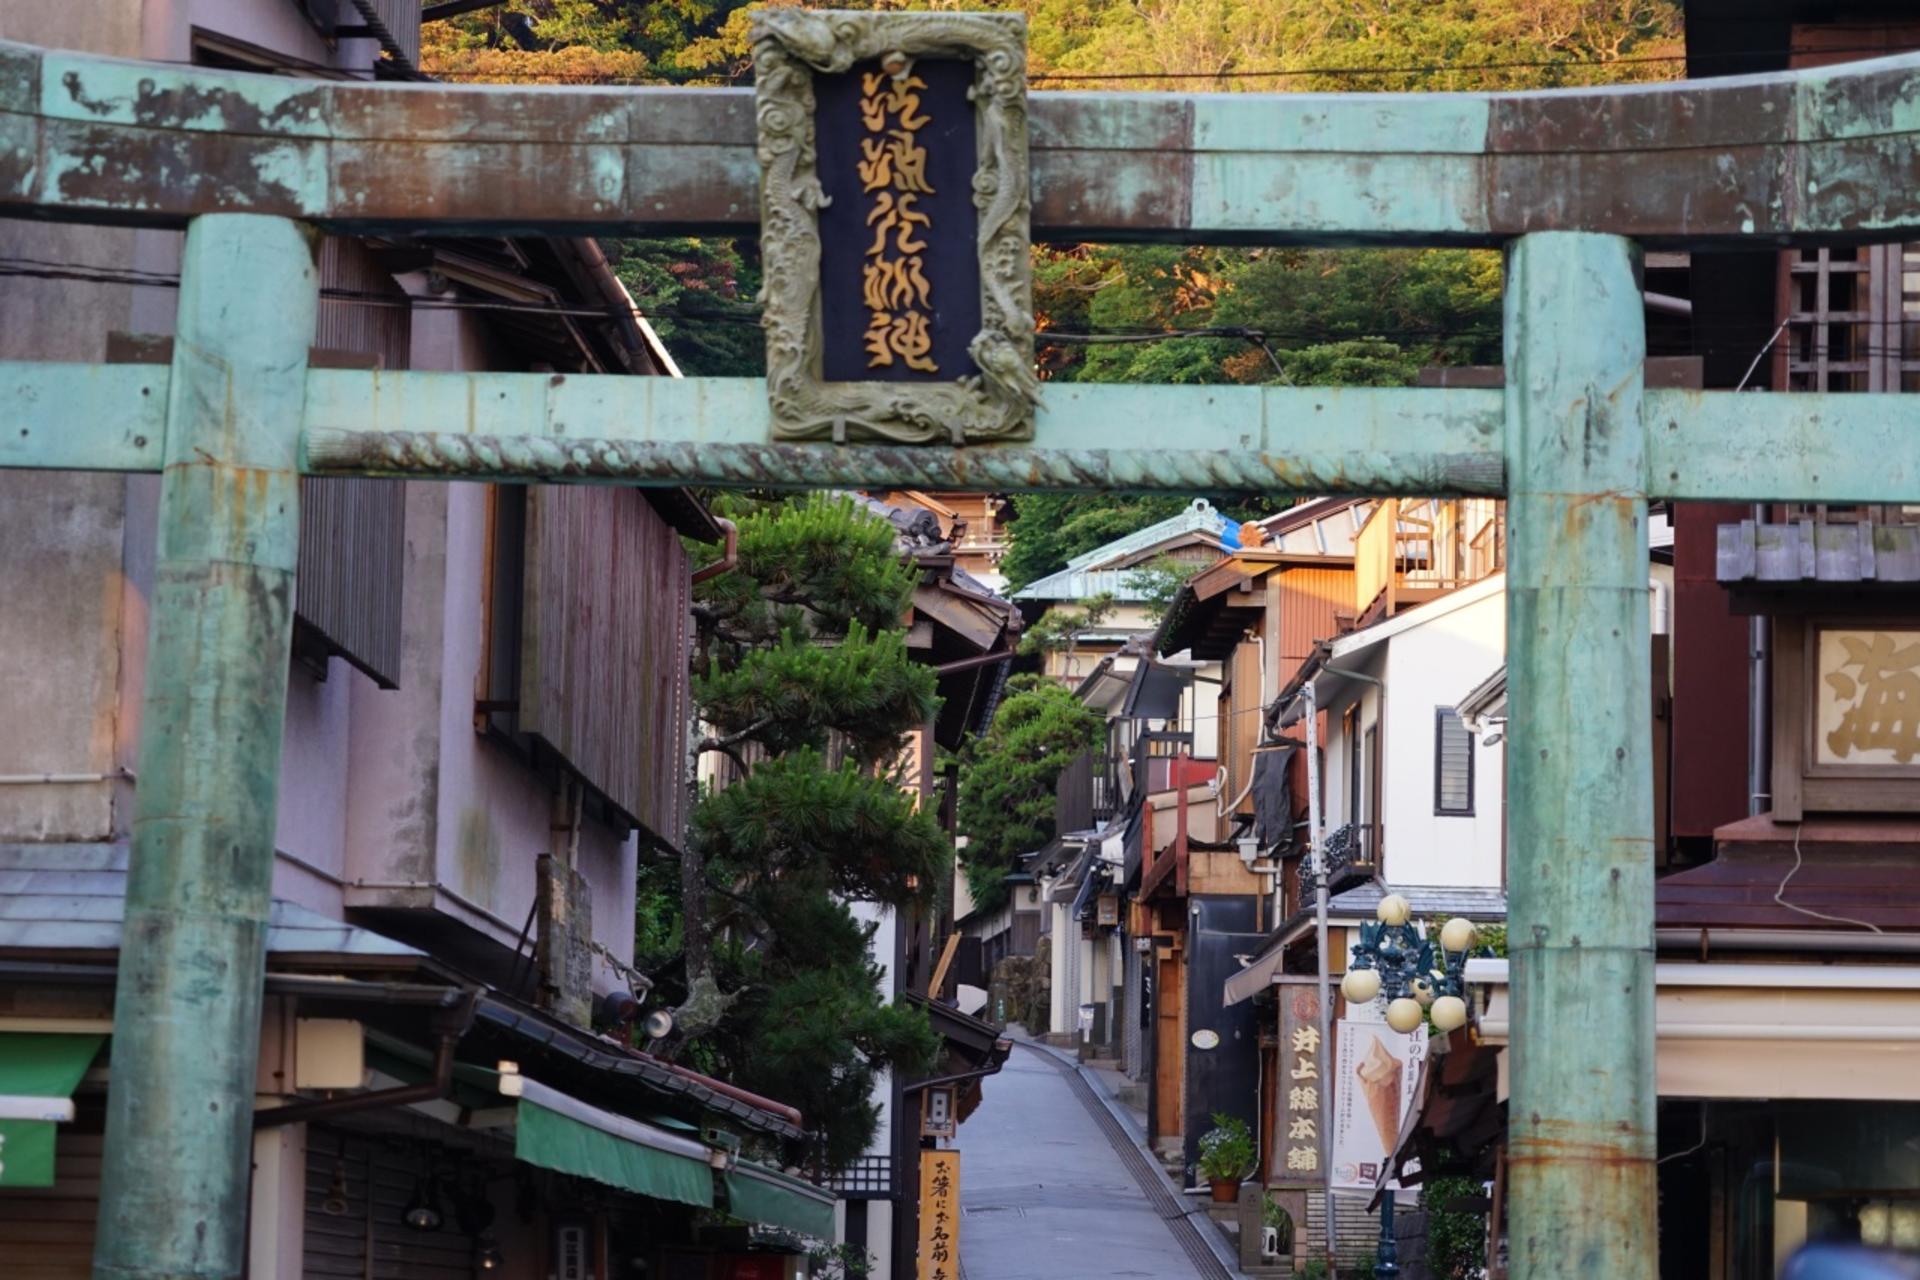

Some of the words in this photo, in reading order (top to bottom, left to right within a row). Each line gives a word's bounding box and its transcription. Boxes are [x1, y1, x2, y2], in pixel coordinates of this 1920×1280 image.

[1287, 1025, 1320, 1171] 井上総本舗
